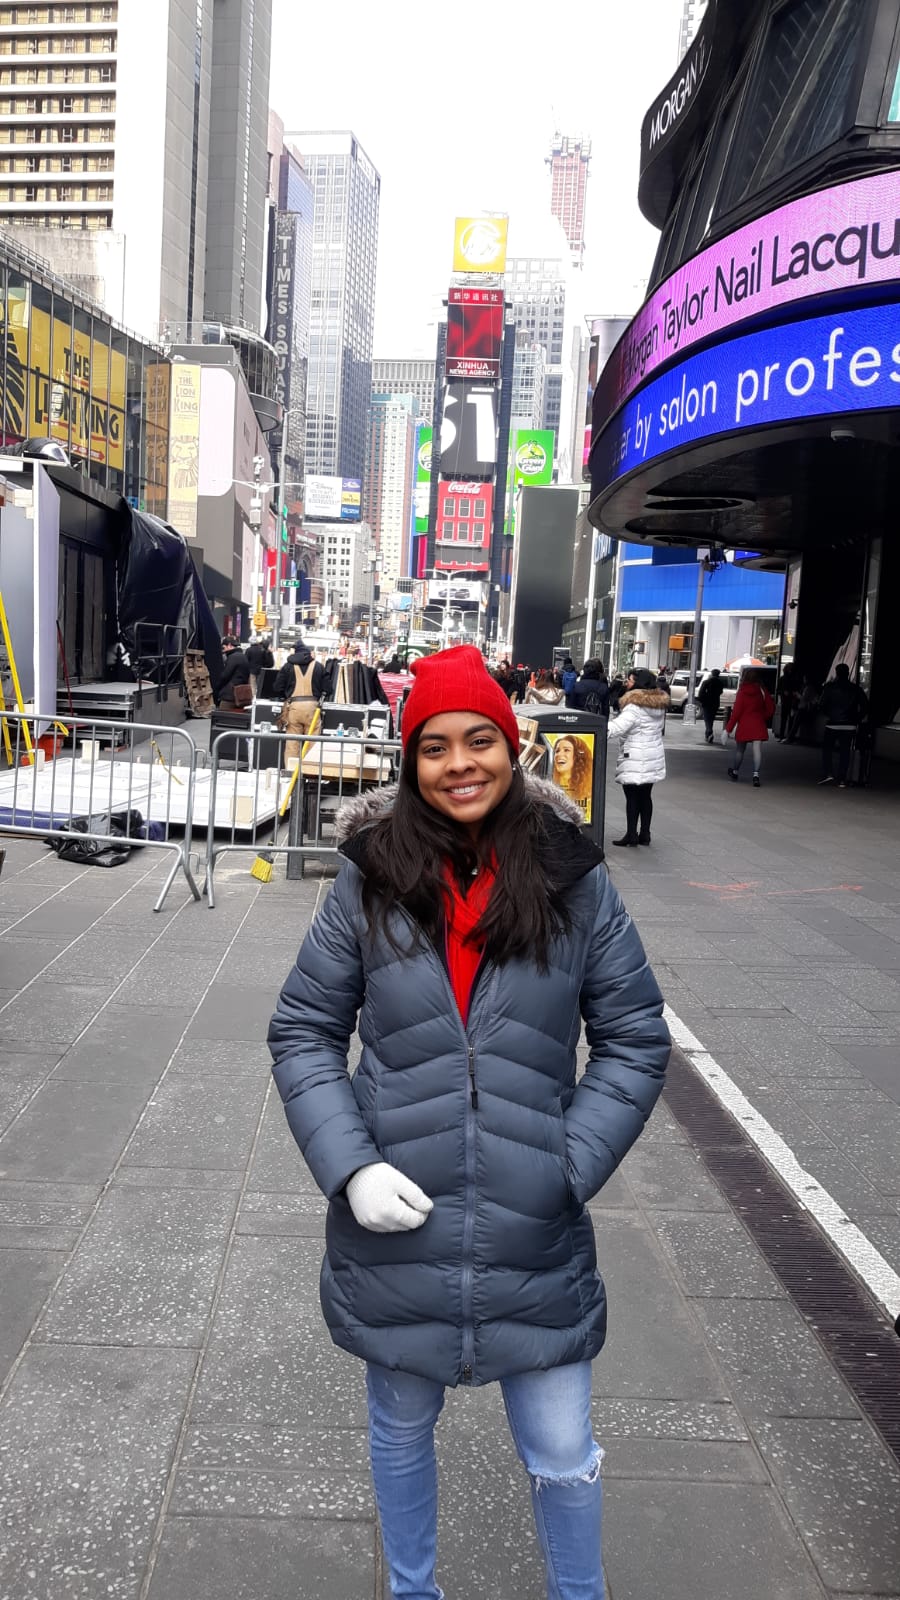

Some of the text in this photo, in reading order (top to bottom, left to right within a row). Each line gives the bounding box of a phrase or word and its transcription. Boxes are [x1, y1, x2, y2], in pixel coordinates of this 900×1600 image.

[649, 51, 698, 151] MORGAN
[662, 275, 709, 349] Taylor
[714, 240, 763, 312] Nail
[771, 218, 900, 285] Lacqu
[274, 235, 291, 407] TIMES SQUAR
[63, 346, 91, 380] THE
[179, 376, 193, 385] THE
[457, 361, 488, 370] XINHUA
[79, 387, 119, 441] KING
[174, 400, 198, 411] KING
[175, 388, 196, 398] LION
[635, 403, 652, 457] by
[659, 374, 717, 435] salon
